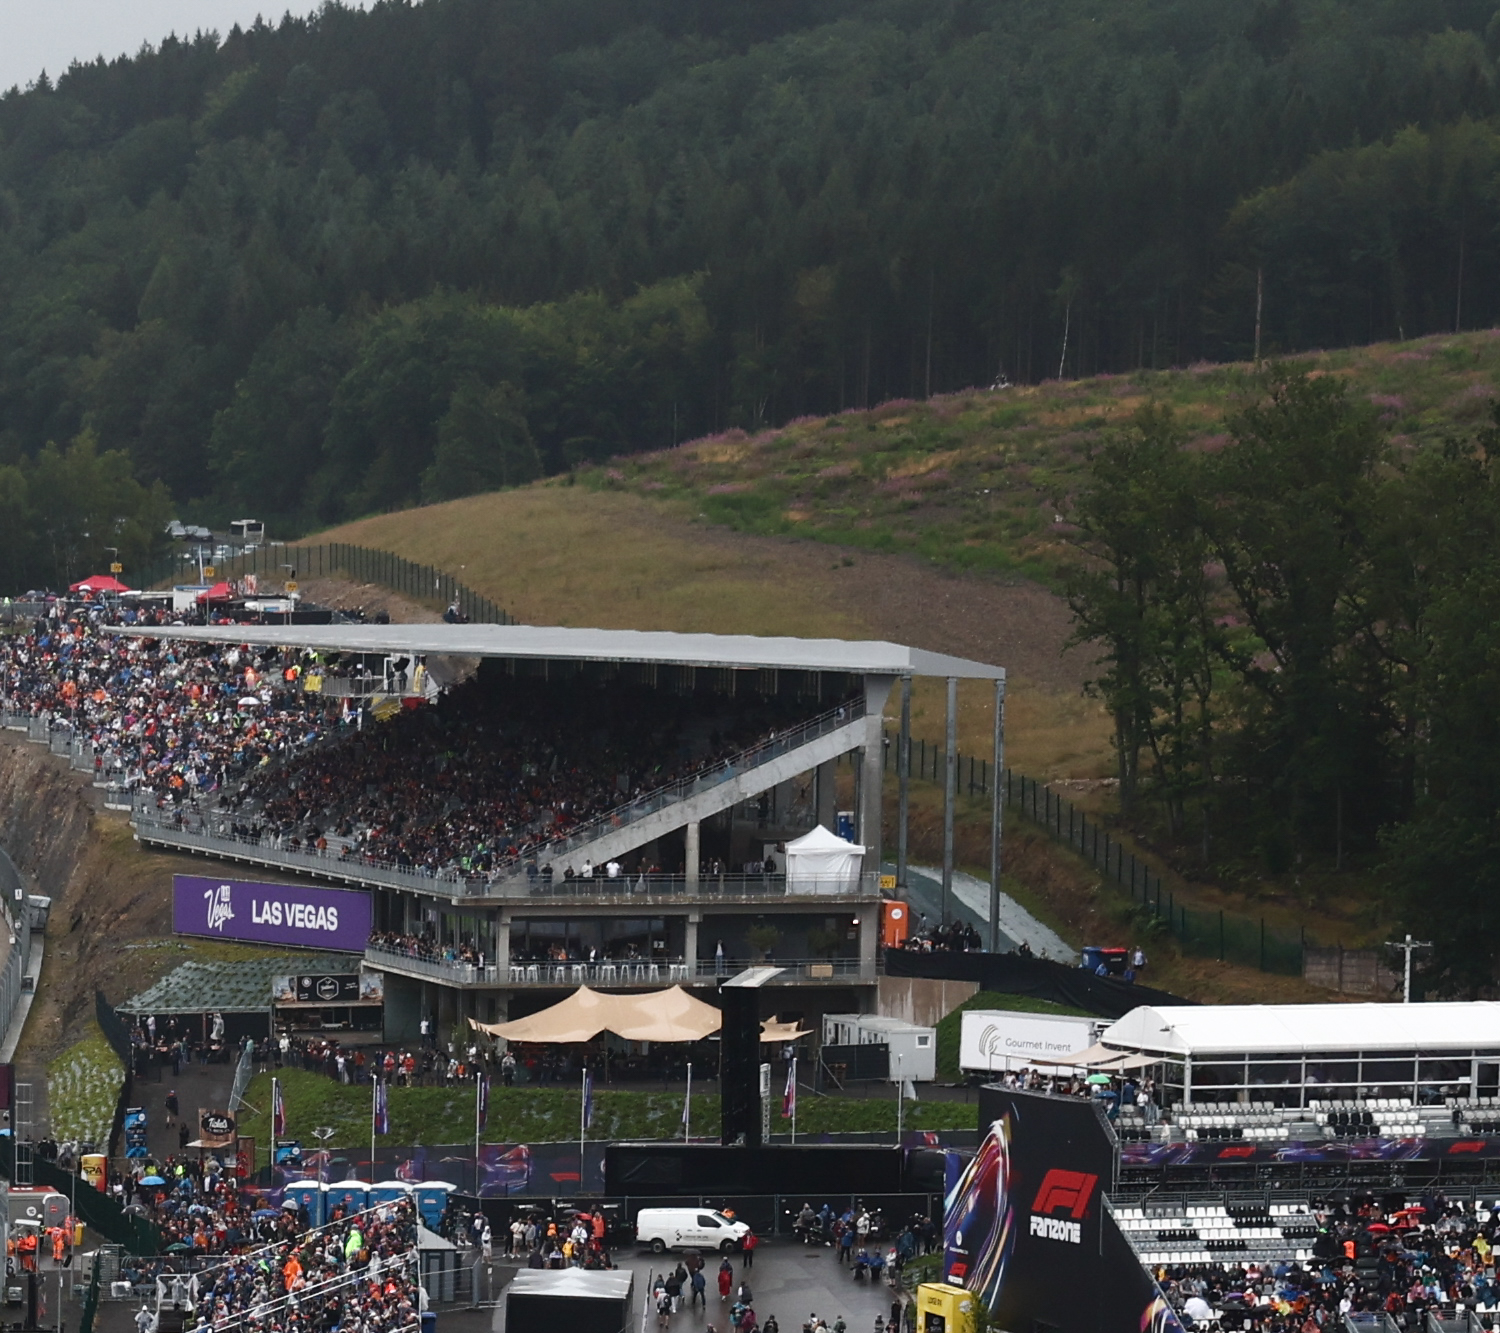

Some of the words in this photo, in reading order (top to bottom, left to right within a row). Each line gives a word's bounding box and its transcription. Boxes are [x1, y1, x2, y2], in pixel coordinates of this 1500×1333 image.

[252, 900, 283, 925] LAS
[284, 903, 338, 931] VEGAS
[1005, 1038, 1042, 1050] Gourmet
[1045, 1040, 1071, 1052] Invent
